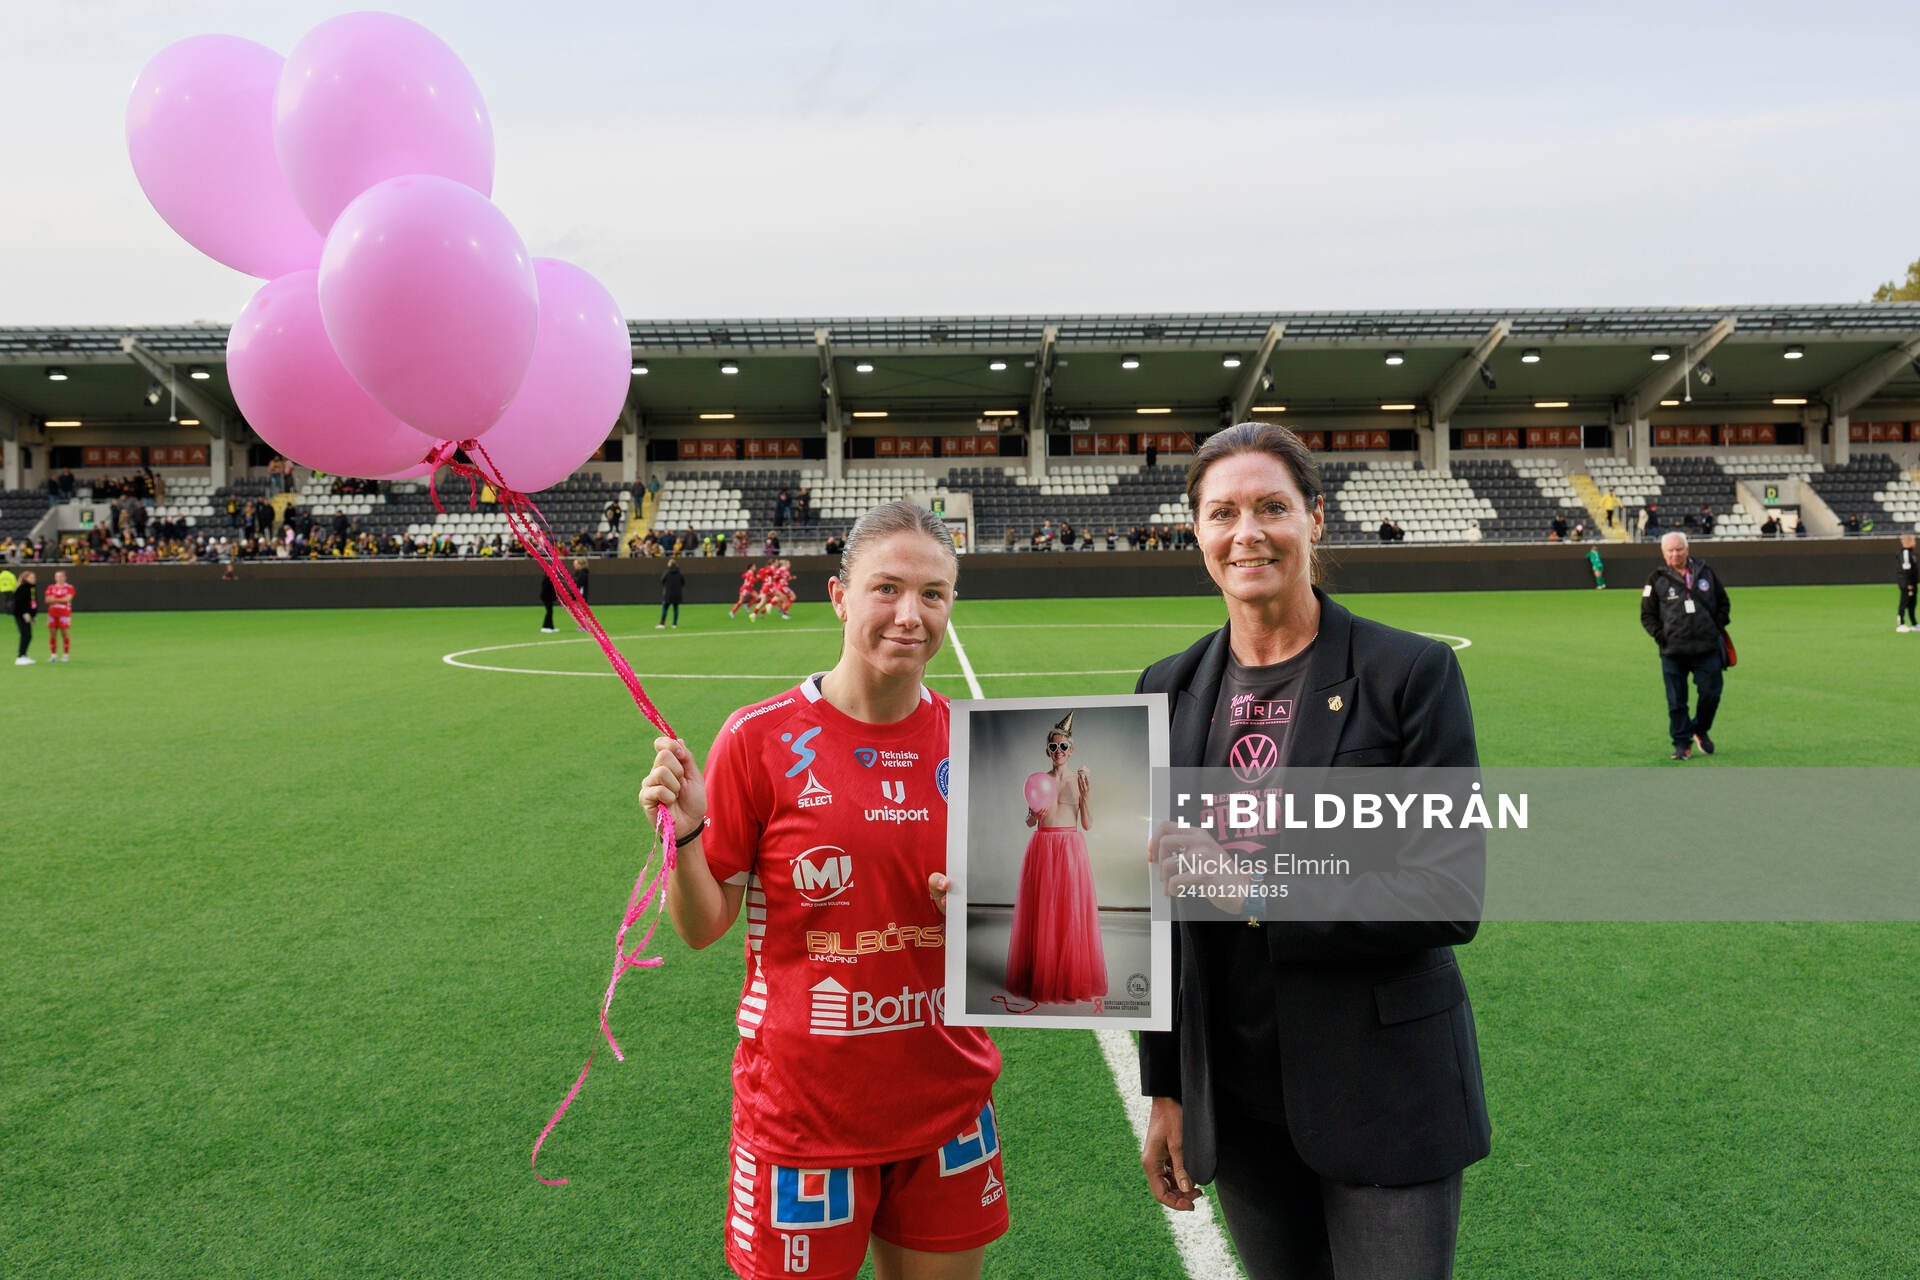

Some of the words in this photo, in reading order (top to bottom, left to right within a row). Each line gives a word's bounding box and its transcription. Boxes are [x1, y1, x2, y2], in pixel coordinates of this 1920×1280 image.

[1468, 432, 1516, 442] BRA
[1531, 432, 1578, 441] BRA
[1660, 430, 1709, 439] BRA
[1723, 428, 1772, 438] BRA
[1336, 433, 1384, 444] BRA
[684, 442, 734, 454] BRA
[749, 441, 798, 453] BRA
[881, 442, 931, 450] BRA
[946, 441, 995, 450] BRA
[88, 451, 139, 460] BRA
[154, 450, 205, 460] BRA
[729, 696, 796, 734] Handelsbanken
[879, 750, 919, 760] Tekniska
[881, 760, 913, 768] verken
[797, 795, 833, 809] SELECT
[864, 807, 930, 825] unisport
[808, 953, 858, 964] LINKÖPING
[981, 1187, 1004, 1208] SELECT
[780, 1233, 810, 1273] 19
